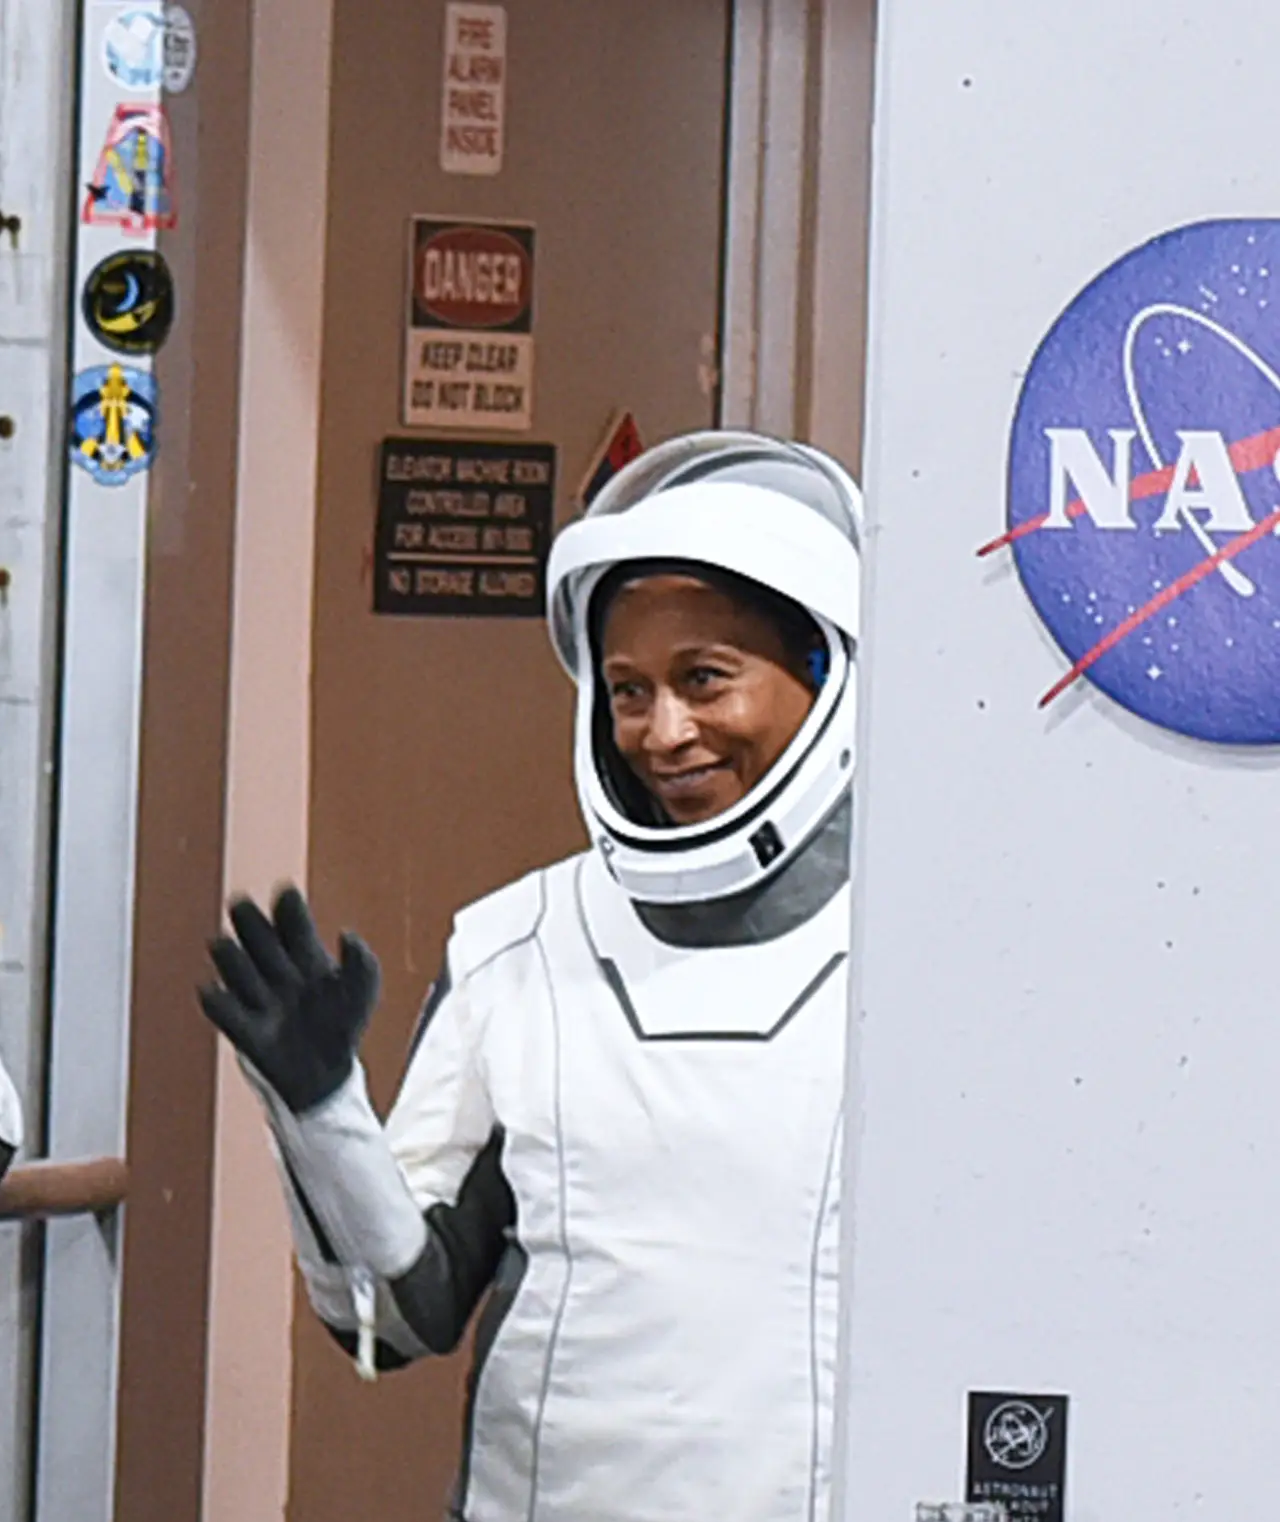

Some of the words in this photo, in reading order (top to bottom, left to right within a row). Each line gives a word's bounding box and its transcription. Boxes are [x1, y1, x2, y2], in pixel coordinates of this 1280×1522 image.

[447, 88, 498, 121] PANEL
[423, 248, 522, 305] DANGER
[421, 341, 464, 371] KEEP
[465, 342, 519, 373] CLEAR
[411, 379, 433, 409] DO
[438, 381, 471, 411] NOT
[472, 382, 526, 413] BLOCK
[1040, 427, 1280, 535] NA
[971, 1481, 1058, 1498] ASTRONAUT
